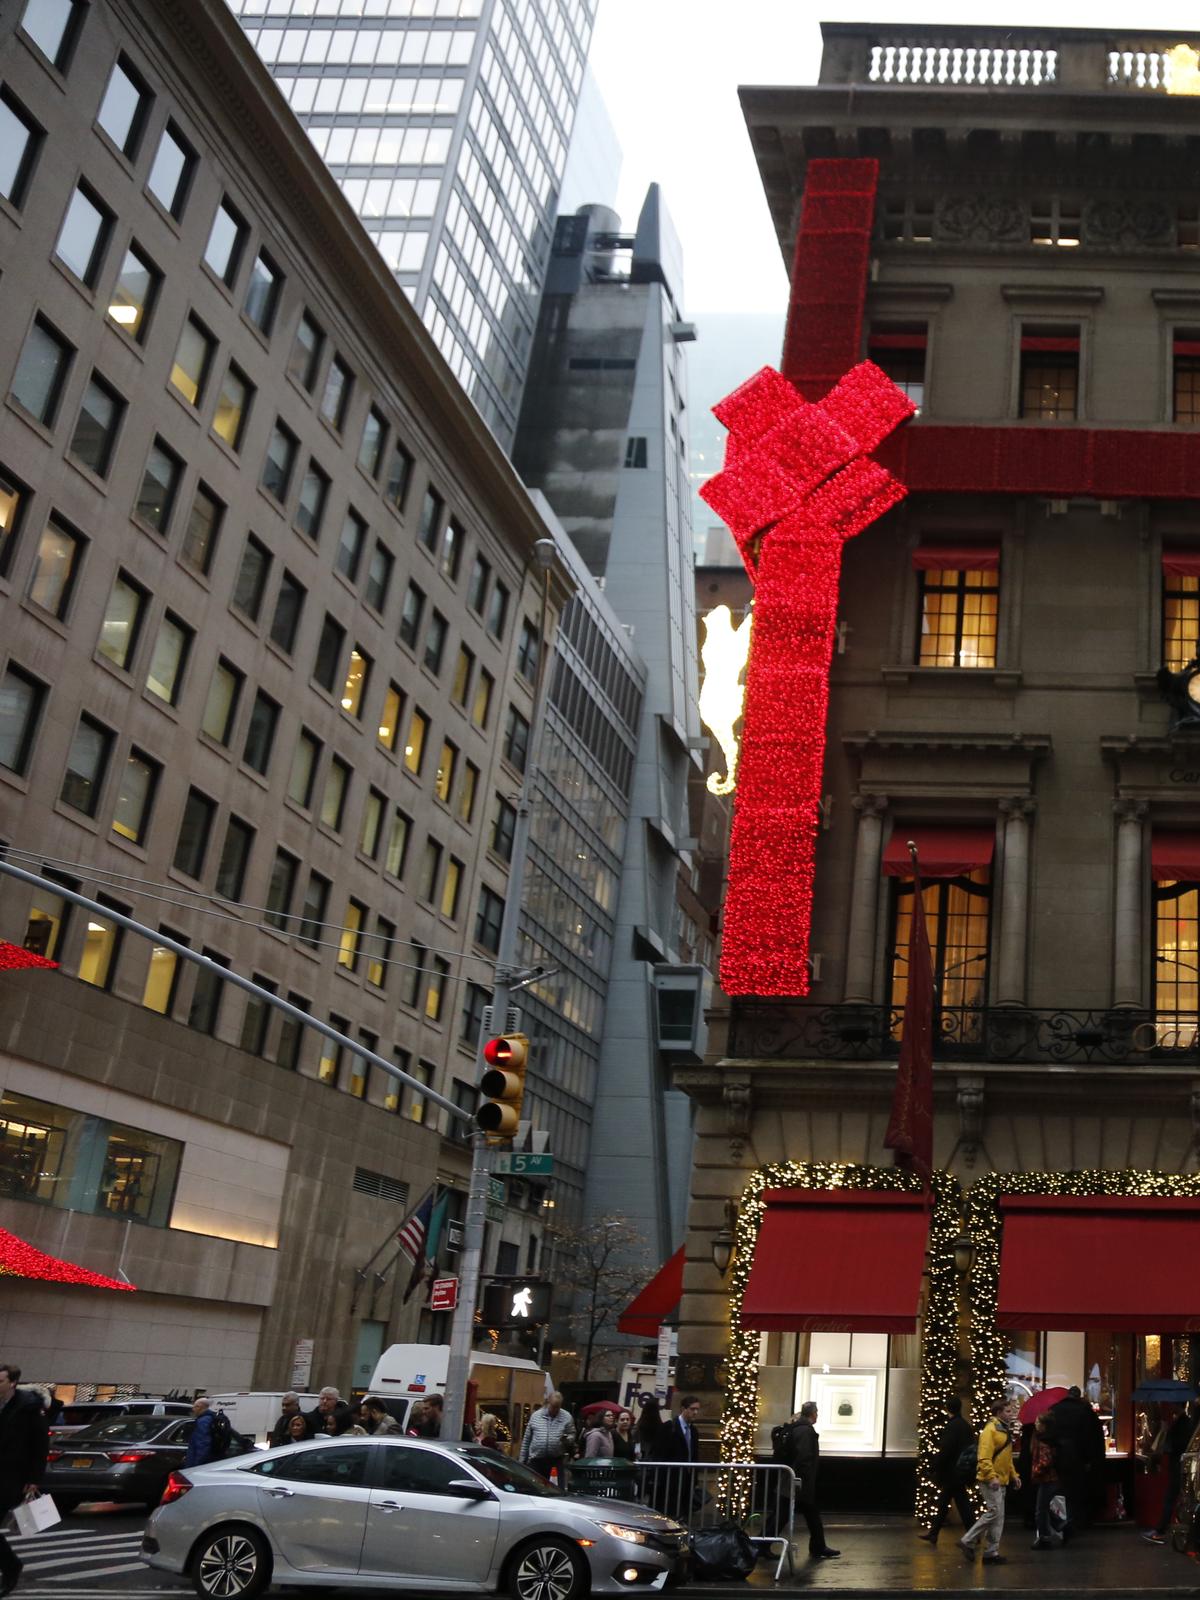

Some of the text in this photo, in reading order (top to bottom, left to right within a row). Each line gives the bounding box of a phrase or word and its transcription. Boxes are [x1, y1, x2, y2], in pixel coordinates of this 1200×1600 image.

[514, 1156, 543, 1171] 5 AV
[803, 1316, 853, 1331] Cartier
